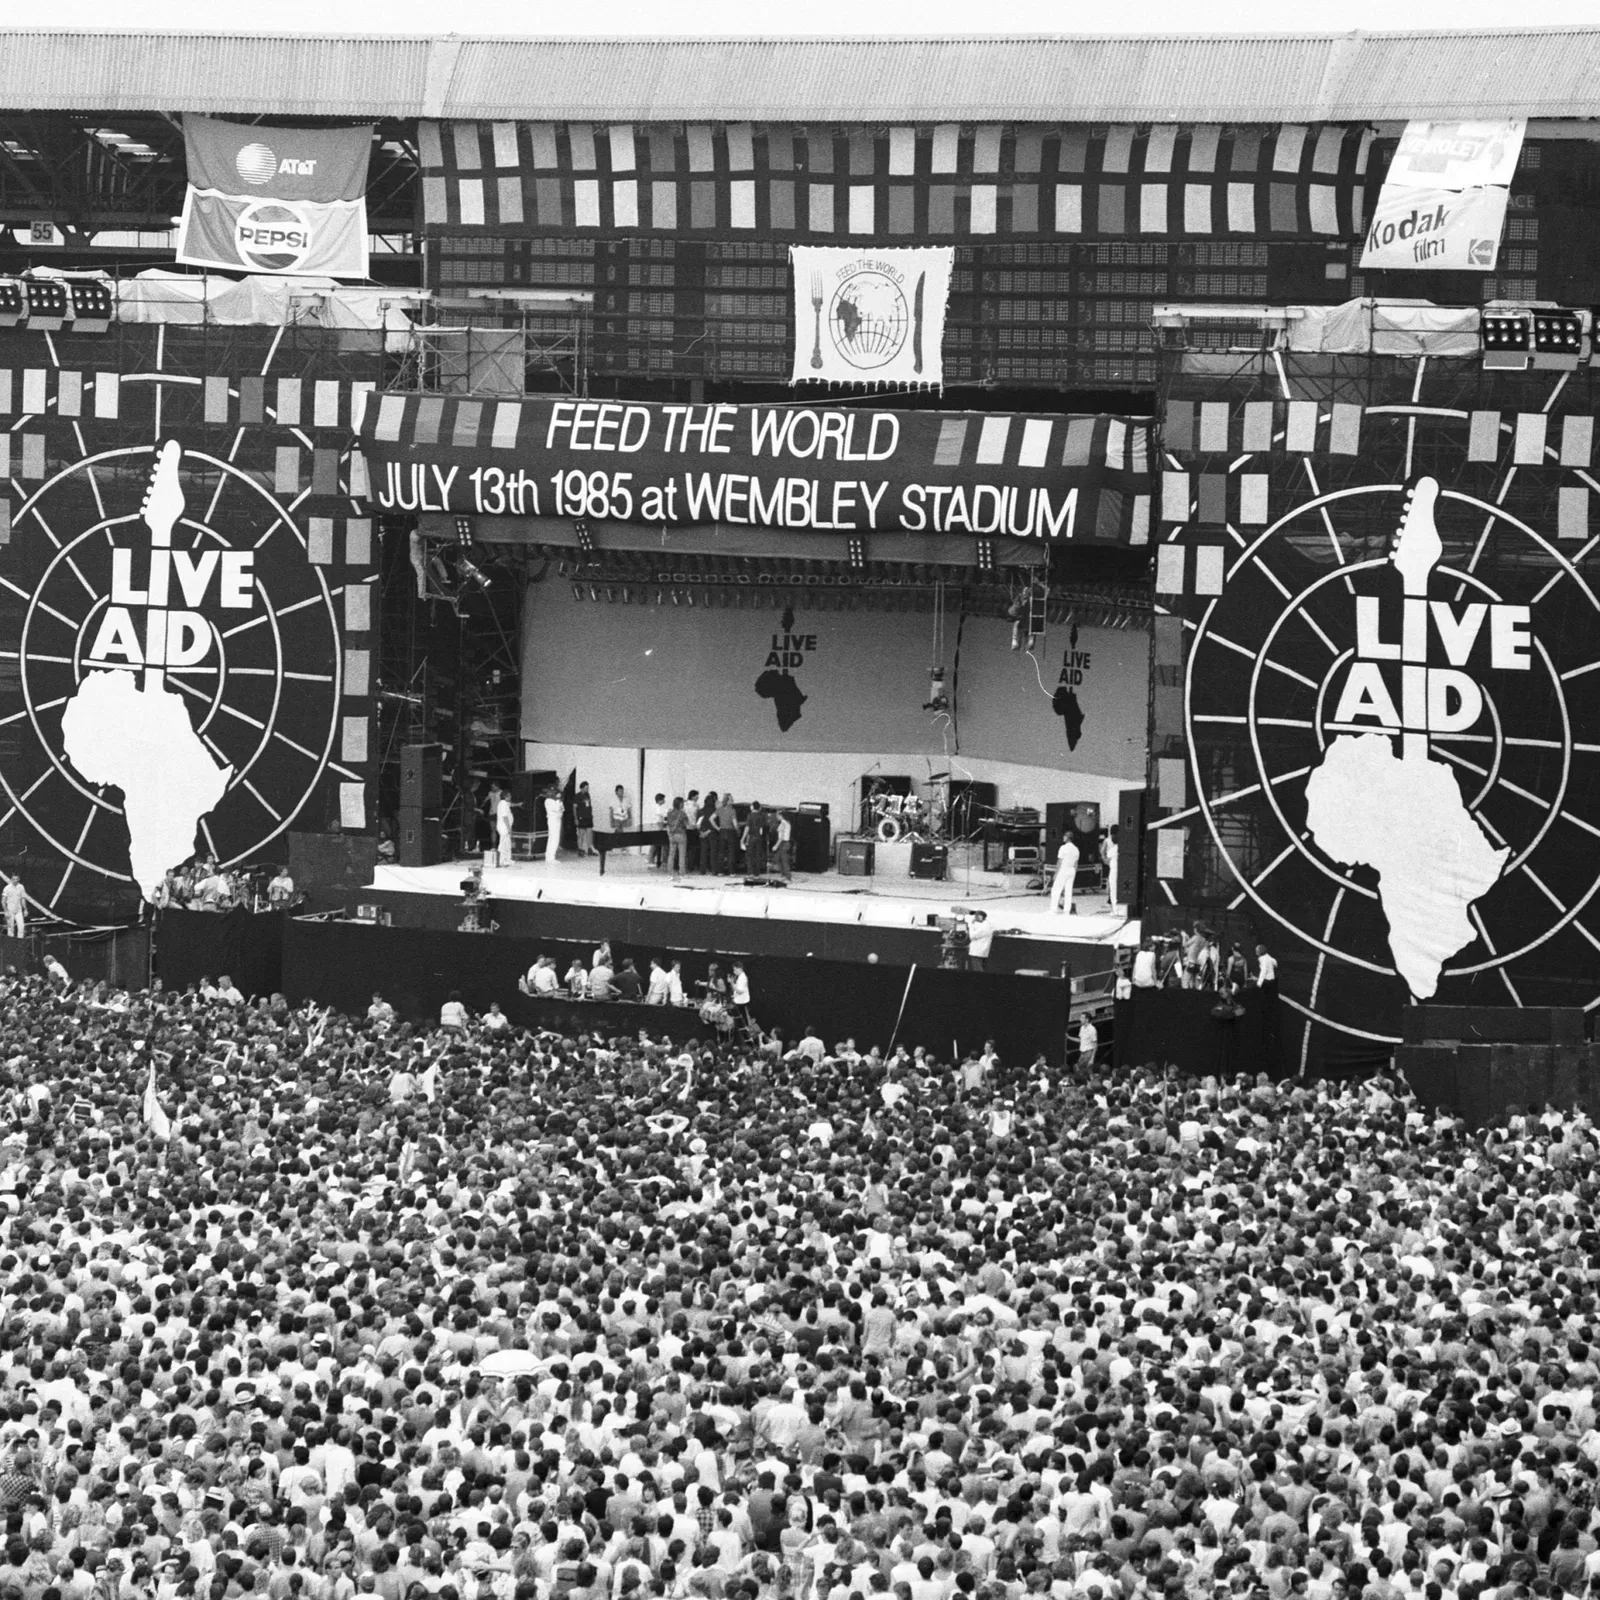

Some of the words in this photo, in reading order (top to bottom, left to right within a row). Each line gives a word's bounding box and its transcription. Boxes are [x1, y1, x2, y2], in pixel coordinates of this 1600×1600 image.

[278, 158, 317, 176] AT&T
[33, 223, 52, 240] 55
[239, 226, 309, 248] PEPSI
[1369, 204, 1451, 253] Kodak
[1413, 238, 1445, 263] film
[836, 263, 857, 281] FEED
[856, 259, 875, 270] THE
[875, 260, 905, 284] WORLD
[546, 402, 651, 453] FEED
[662, 402, 738, 454] THE
[751, 408, 900, 462] WORLD
[378, 462, 459, 512] JULY
[469, 466, 540, 515] 13th
[550, 469, 633, 519] 1985
[641, 477, 679, 521] at
[685, 472, 888, 533] WEMBLEY
[899, 483, 1079, 538] STADIUM
[111, 547, 254, 609] LIVE
[89, 606, 212, 666] AID
[772, 634, 817, 651] LIVE
[1356, 595, 1531, 670] LIVE
[764, 651, 804, 668] AID
[1063, 650, 1091, 670] LIVE
[1058, 668, 1083, 687] AID
[1334, 662, 1482, 732] AID
